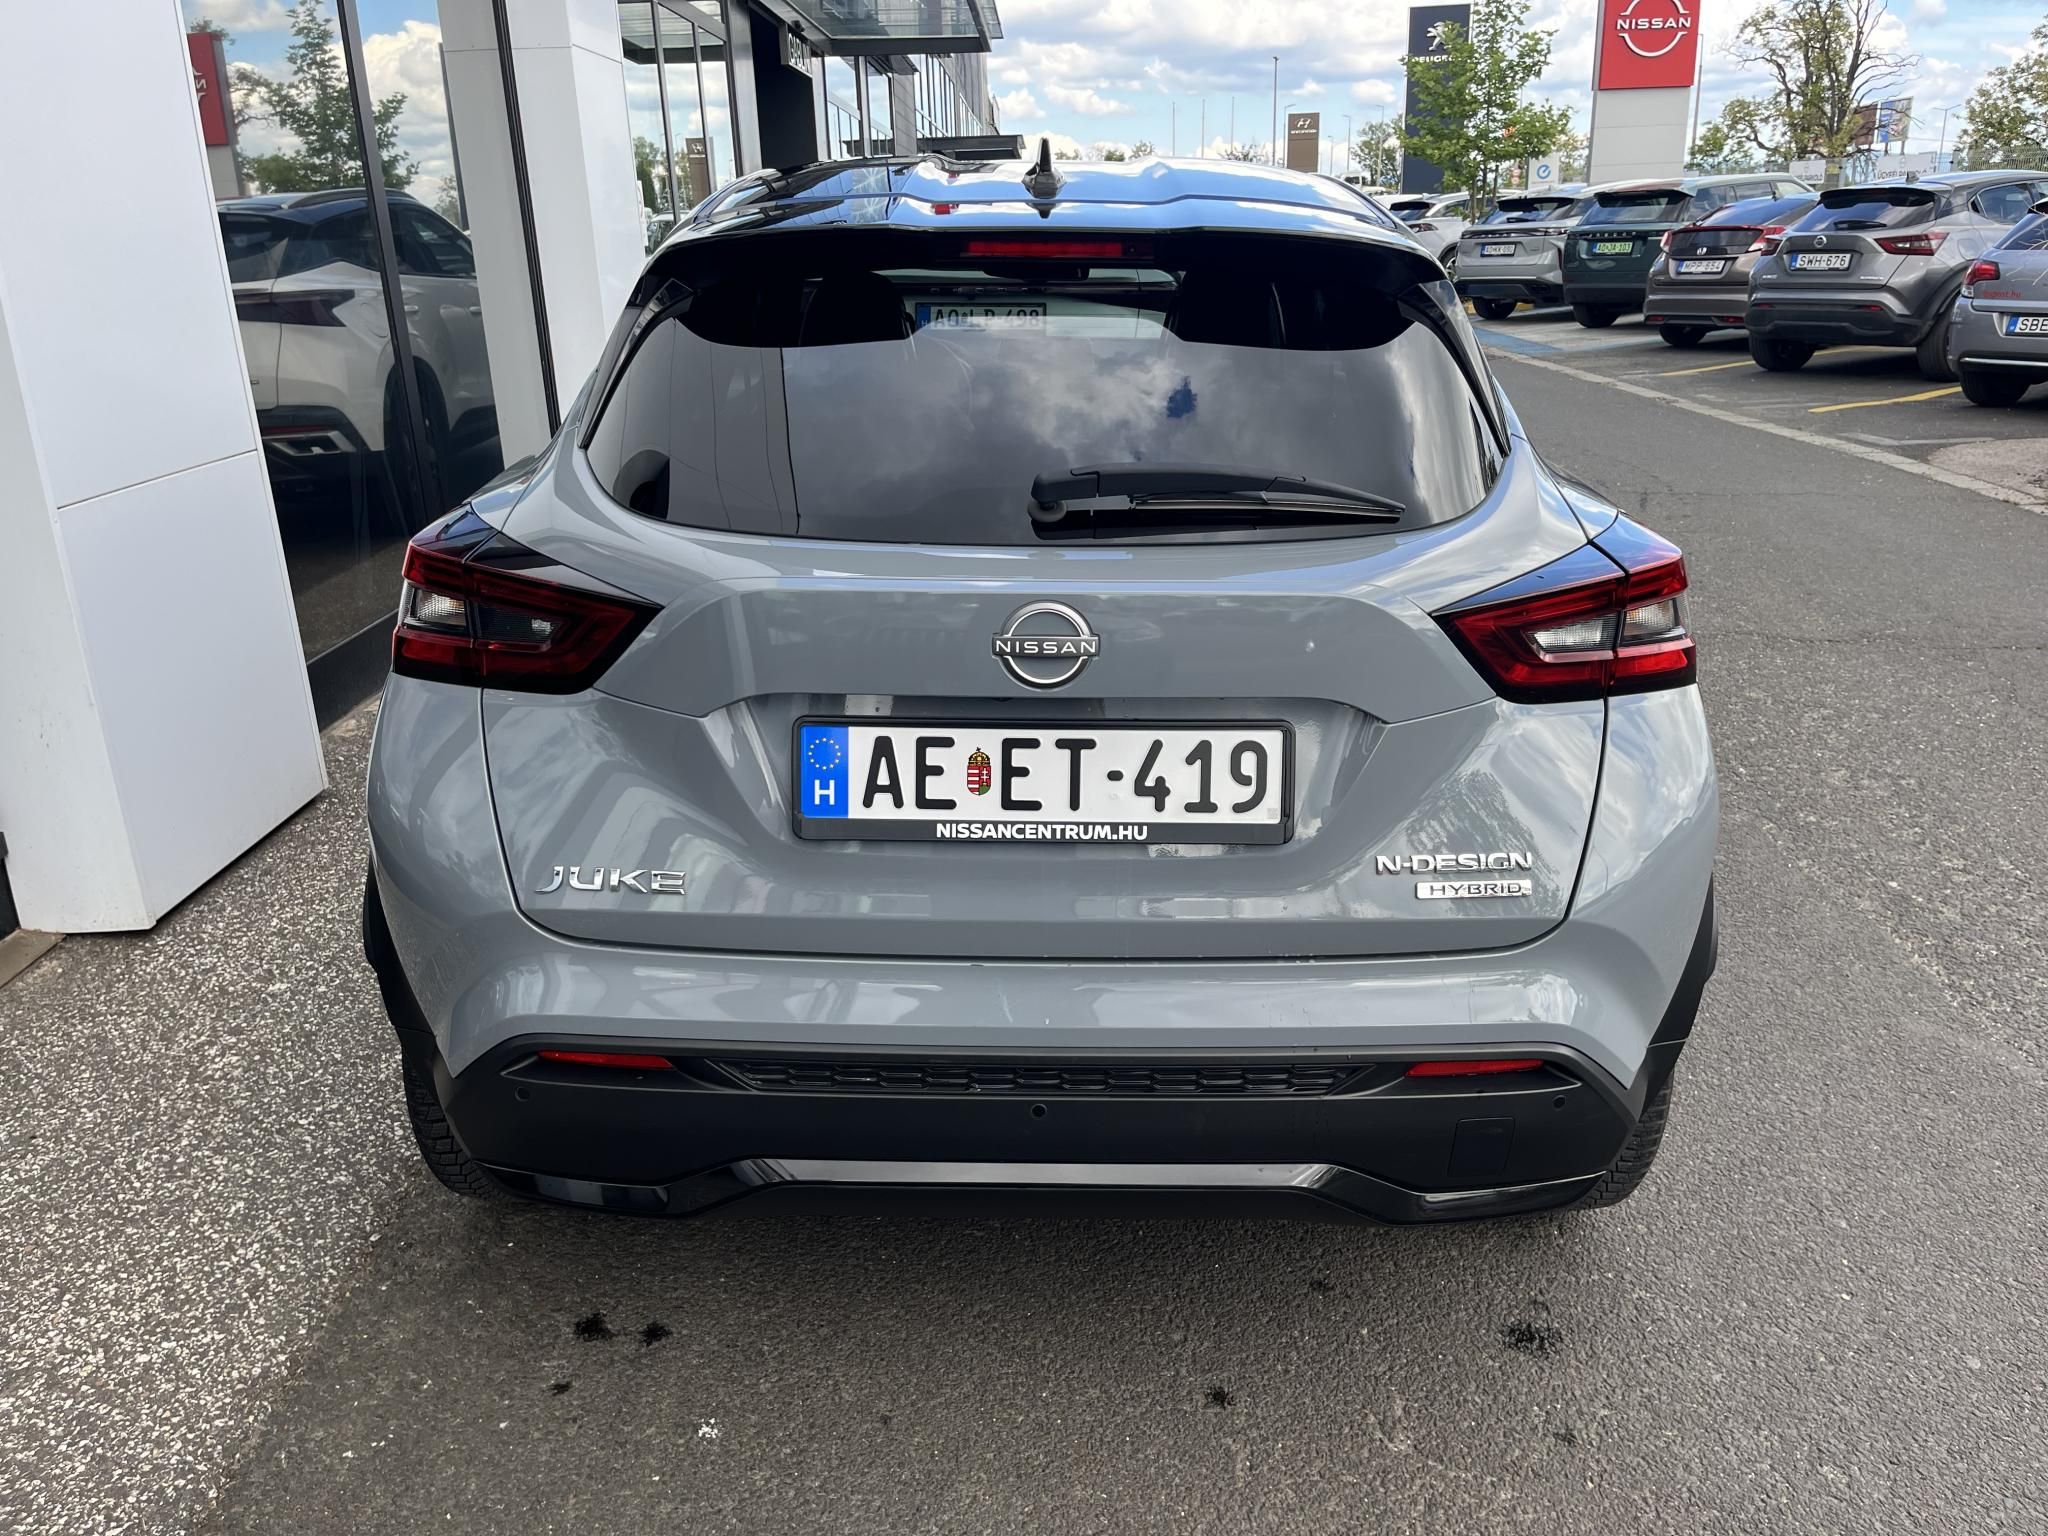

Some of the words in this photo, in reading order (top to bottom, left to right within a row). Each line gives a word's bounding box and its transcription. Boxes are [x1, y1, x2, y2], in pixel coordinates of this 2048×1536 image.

[1616, 17, 1692, 30] NISSAN
[1799, 255, 1847, 267] SWH-676
[996, 640, 1096, 653] NISSAN
[814, 779, 835, 805] H
[936, 823, 1148, 840] NISSANCENTRUM.HU
[1376, 852, 1532, 874] N-DESIGN
[535, 866, 686, 895] JUKE
[1430, 883, 1521, 895] HYBRID
